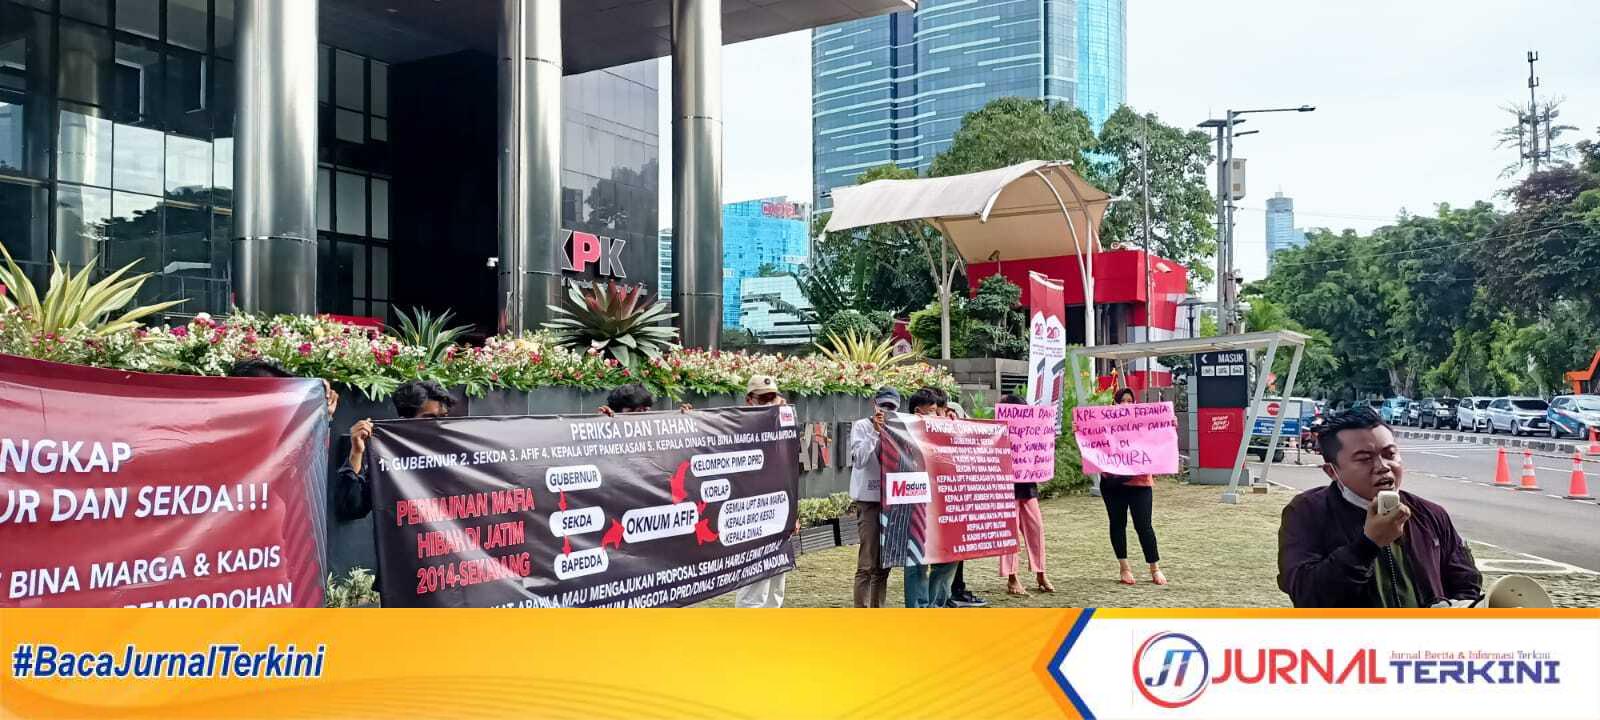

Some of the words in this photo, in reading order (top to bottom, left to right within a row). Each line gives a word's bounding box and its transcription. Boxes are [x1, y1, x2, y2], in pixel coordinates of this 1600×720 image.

[561, 229, 627, 278] KPK
[1218, 353, 1244, 363] MASUK
[997, 407, 1034, 419] MADURA
[1076, 409, 1096, 421] KPK
[1100, 408, 1131, 420] SEGERA
[570, 421, 622, 440] PERIKSA
[624, 420, 652, 438] DAN
[654, 418, 698, 435] TAHAN:
[379, 458, 390, 471] 1.
[392, 453, 457, 470] GUBERNUR
[460, 452, 470, 465] 2.
[473, 450, 508, 465] SEKDA
[510, 449, 519, 462] 3.
[521, 448, 540, 461] AFIF
[542, 447, 550, 459] 4.
[551, 445, 582, 458] KEPALA
[584, 444, 597, 456] UPT
[600, 441, 646, 455] PAMEKASAN
[648, 441, 655, 452] 5.
[656, 439, 683, 451] KEPALA
[685, 437, 706, 448] DINAS
[707, 436, 716, 447] PU
[718, 434, 733, 445] BINA
[734, 433, 754, 444] MARGA
[761, 431, 778, 442] KEPALA
[1119, 439, 1130, 448] DI
[694, 458, 730, 471] KELOMPOK
[731, 455, 746, 467] PIMP.
[748, 454, 762, 466] DPRD
[1096, 449, 1152, 467] MADURA
[550, 470, 598, 487] GUBERNUR
[704, 484, 729, 498] KORLAP
[892, 480, 927, 496] Madura
[938, 484, 958, 493] KEPALA
[50, 487, 128, 522] DAN
[134, 482, 268, 518] SEKDA!!!
[746, 498, 756, 511] UPT
[757, 496, 769, 508] BINA
[944, 494, 963, 502] KEPALA
[396, 493, 488, 526] PERMAINAN
[492, 488, 535, 514] MAFIA
[945, 504, 964, 513] KEPALA
[562, 514, 592, 529] SEKDA
[626, 512, 670, 535] OKNUM
[673, 510, 695, 528] AFIF
[747, 513, 759, 525] BIRO
[938, 515, 958, 524] KEPALA
[417, 529, 465, 558] HIBAH
[466, 526, 481, 550] DI
[484, 521, 525, 549] JATIM
[747, 526, 762, 539] DINAS
[9, 566, 80, 599] BINA
[89, 555, 186, 590] MARGA
[193, 552, 210, 578] &
[217, 545, 280, 574] KADIS
[561, 554, 603, 573] BAPEDDA
[416, 552, 531, 594] 2014-SEKARANG
[562, 588, 587, 607] MAU
[590, 572, 654, 602] MENGAJUKAN
[656, 564, 698, 587] PROPOSAL
[698, 557, 724, 576] SEMUA
[725, 551, 746, 569] HARUS
[627, 589, 669, 608] ANGGOTA
[763, 553, 790, 571] MADURA
